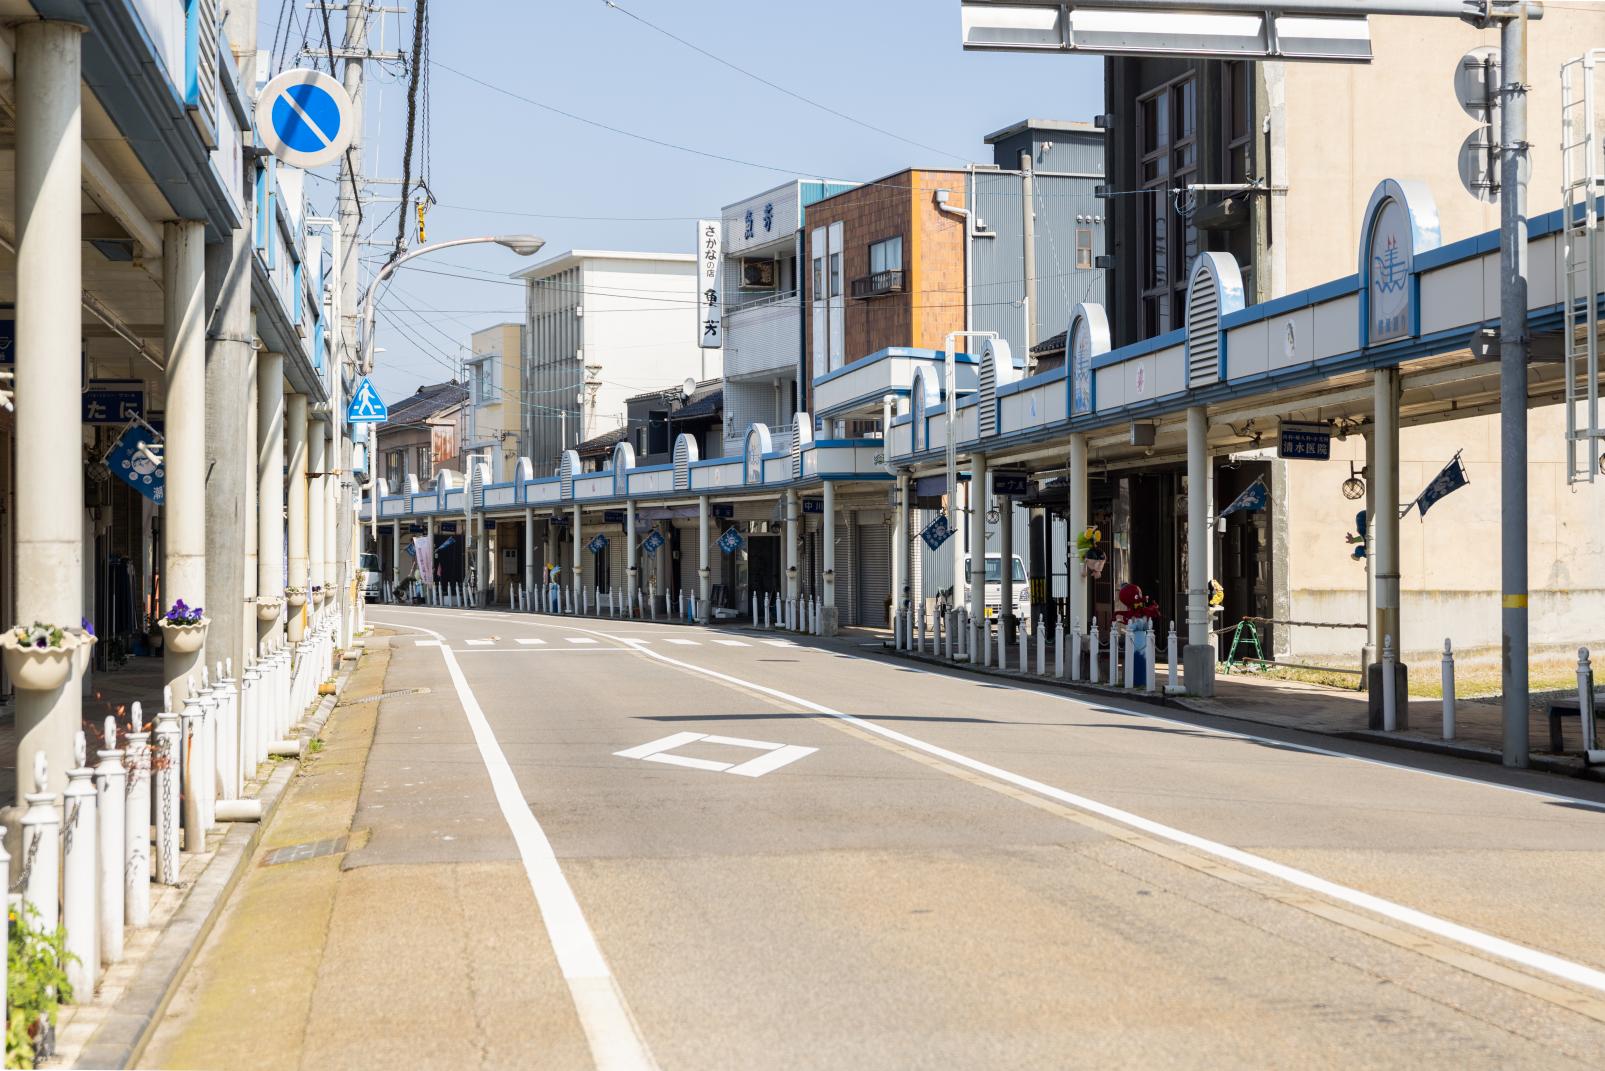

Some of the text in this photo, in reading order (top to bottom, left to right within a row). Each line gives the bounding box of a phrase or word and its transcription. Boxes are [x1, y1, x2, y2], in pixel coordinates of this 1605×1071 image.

[705, 225, 717, 278] さかなの店
[1283, 441, 1328, 454] 清水医院
